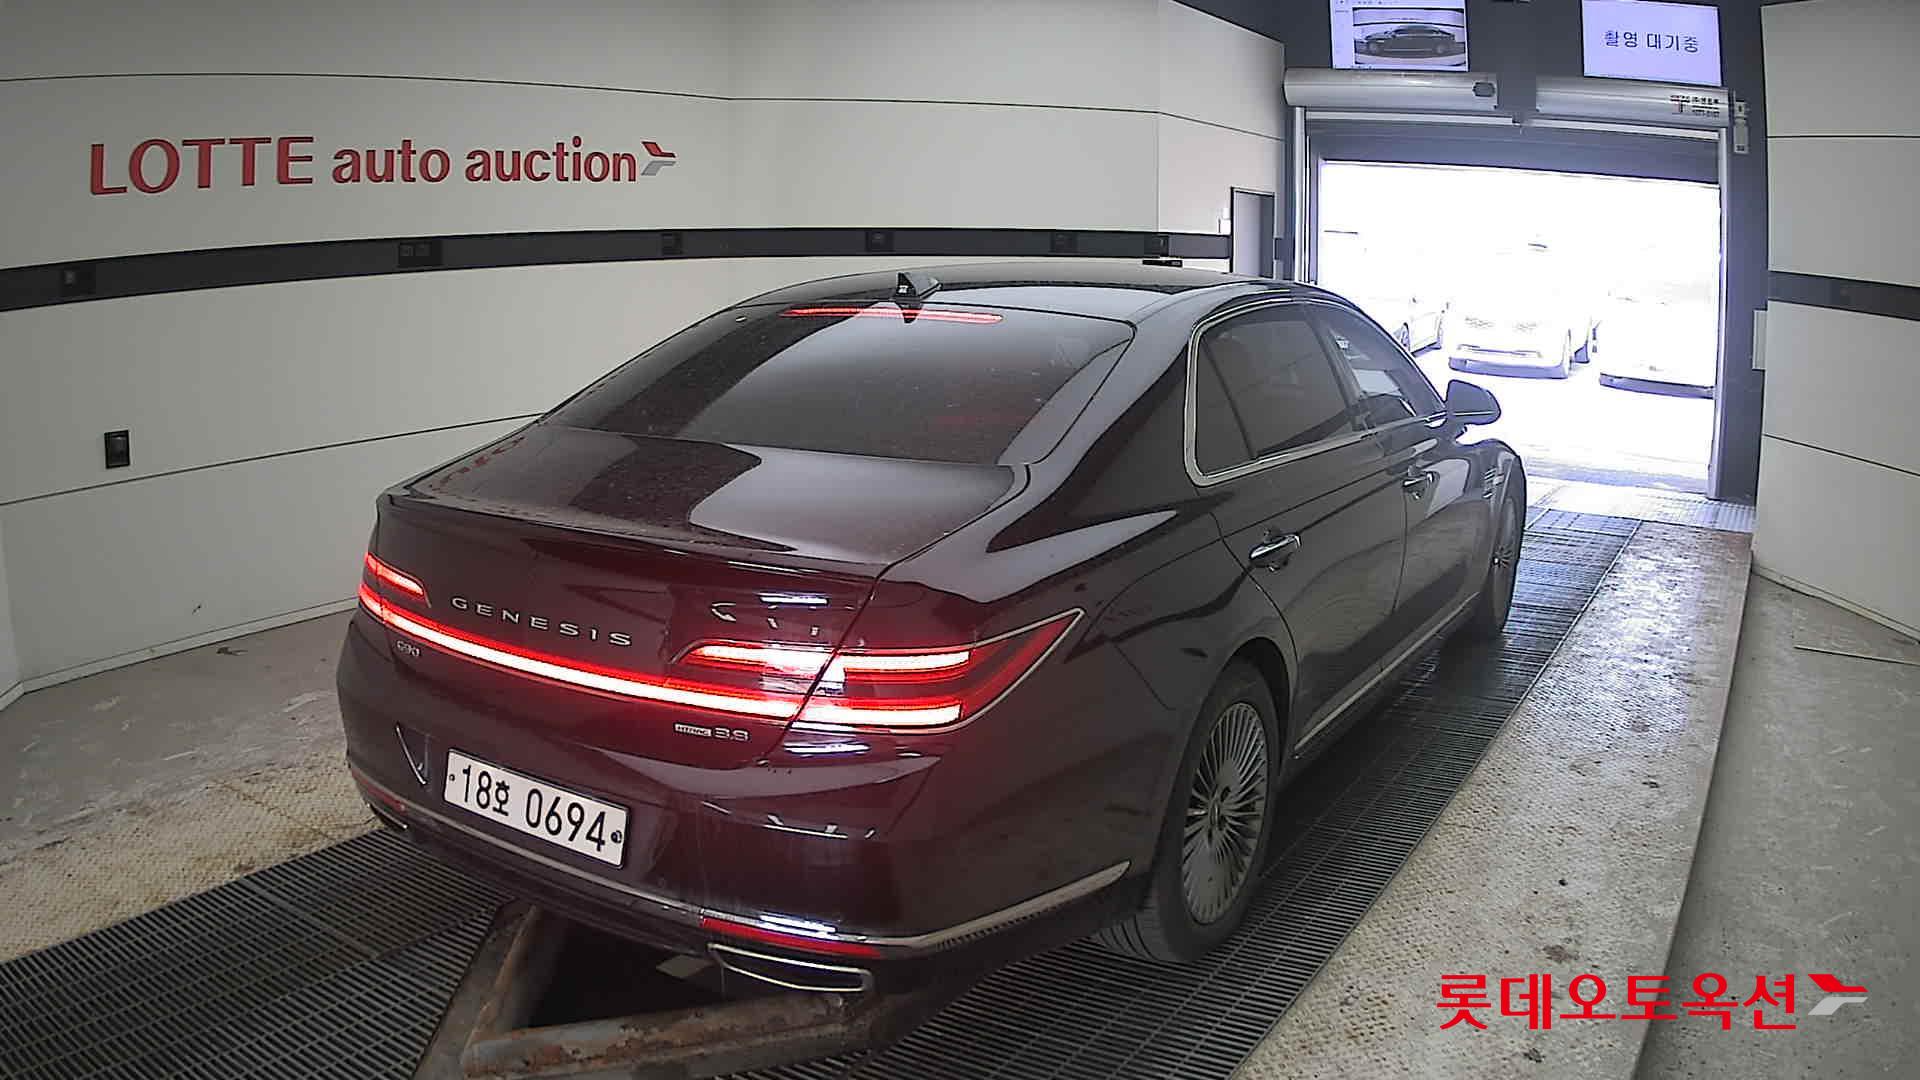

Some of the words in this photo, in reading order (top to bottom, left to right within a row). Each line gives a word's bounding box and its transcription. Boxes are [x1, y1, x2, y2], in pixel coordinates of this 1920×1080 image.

[1605, 30, 1638, 47] 촬영
[1647, 33, 1698, 52] 대기중
[90, 136, 313, 195] LOTTE
[332, 139, 450, 183] auto
[465, 136, 637, 182] auction
[452, 597, 632, 647] GENESIS
[462, 765, 510, 817] 18호
[525, 788, 606, 852] 0694
